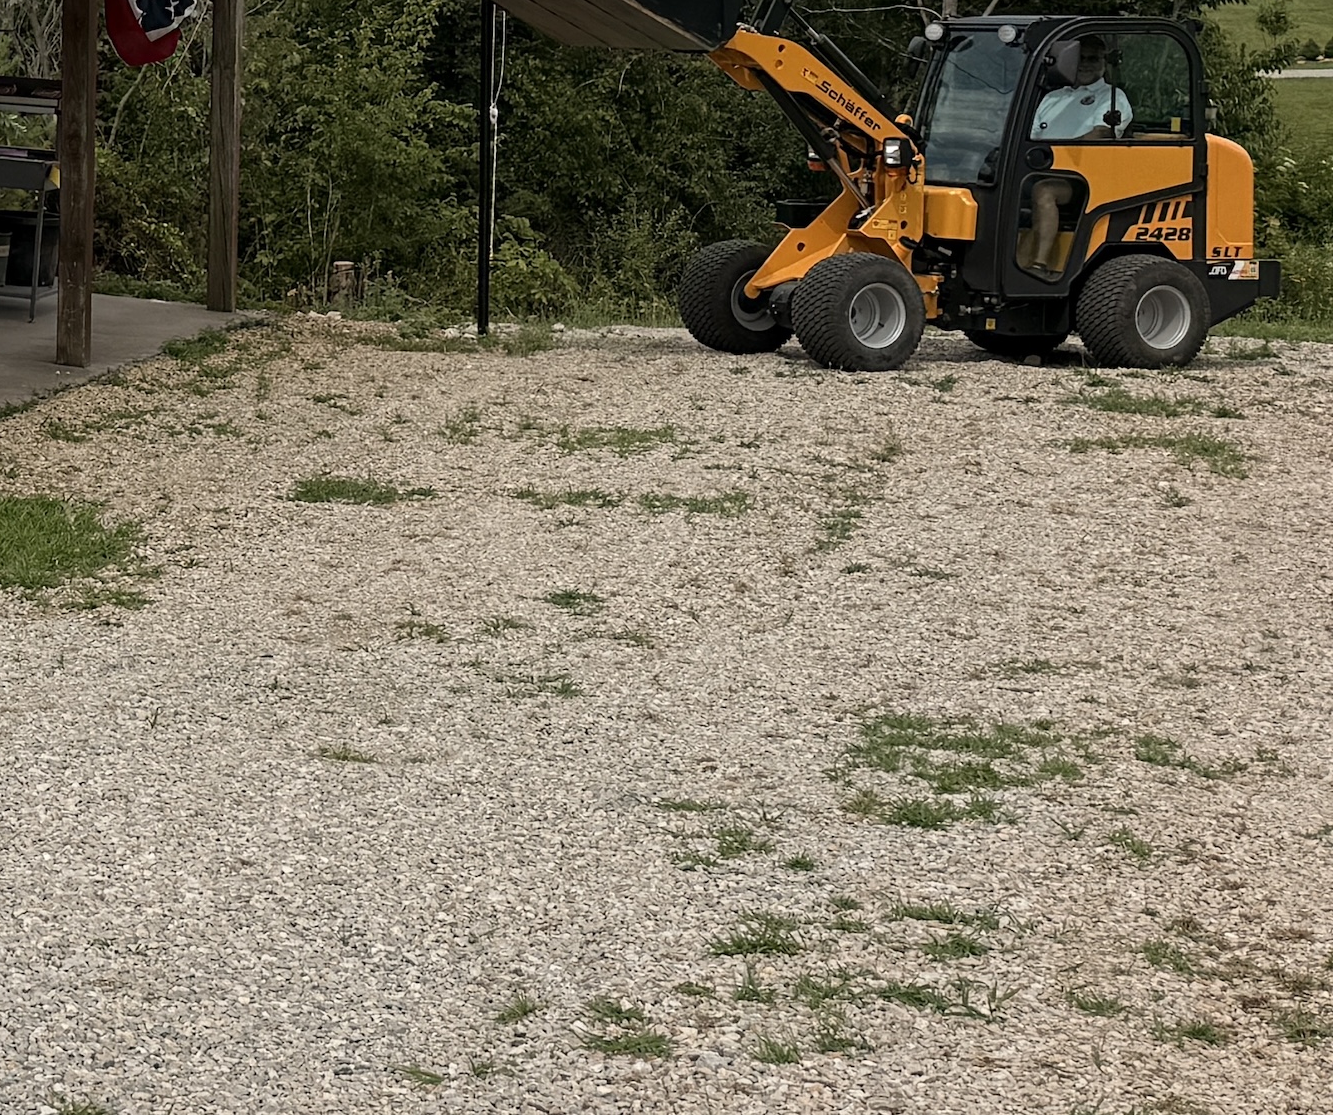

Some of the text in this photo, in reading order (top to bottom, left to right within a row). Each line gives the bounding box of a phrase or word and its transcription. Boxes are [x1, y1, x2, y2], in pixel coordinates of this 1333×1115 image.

[815, 80, 882, 131] Schäffer
[1135, 227, 1192, 241] 2428
[1211, 246, 1243, 258] SLT
